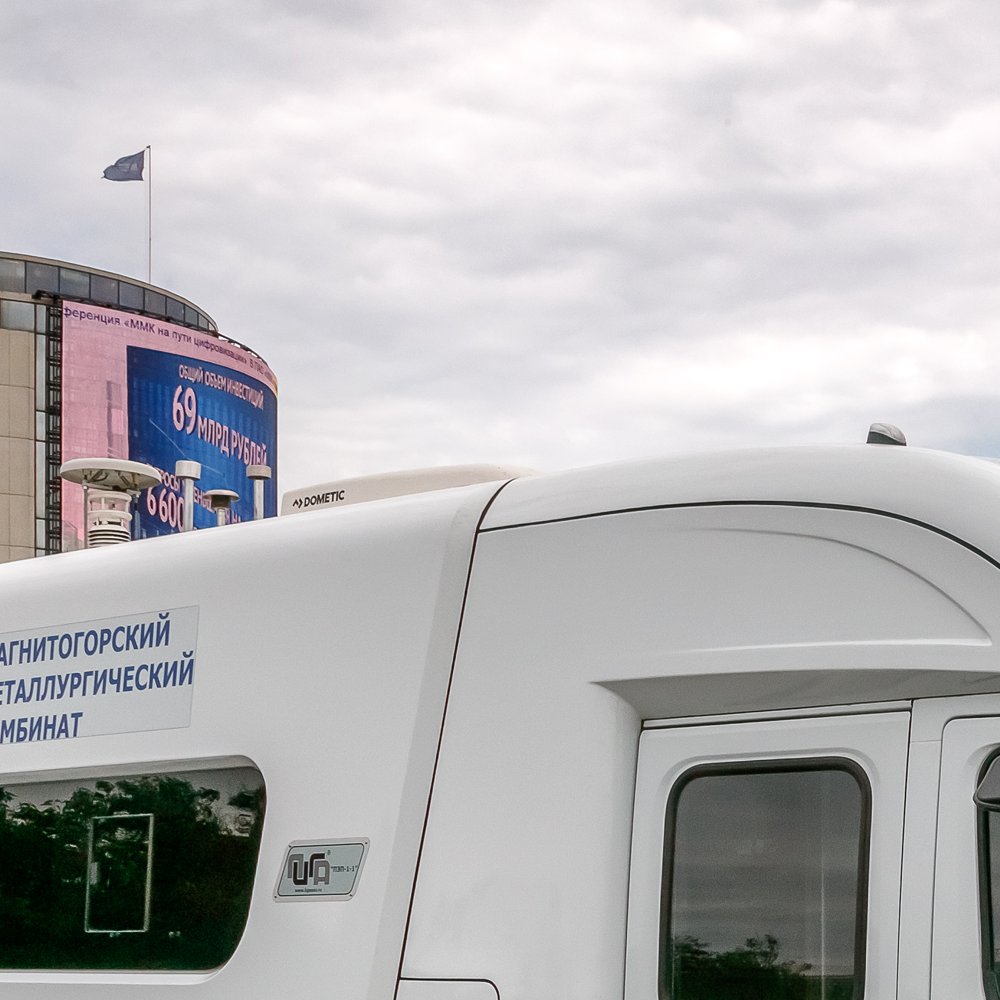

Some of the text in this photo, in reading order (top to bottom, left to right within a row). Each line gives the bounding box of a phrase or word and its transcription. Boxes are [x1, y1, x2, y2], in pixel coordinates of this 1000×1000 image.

[158, 329, 170, 337] на
[172, 331, 192, 343] пути
[179, 364, 203, 384] ОБЩИЙ
[172, 384, 267, 466] 69 МЛРД РУБЛЕЙ
[304, 490, 345, 507] DOMETIC
[0, 712, 83, 743] МБИНАТ
